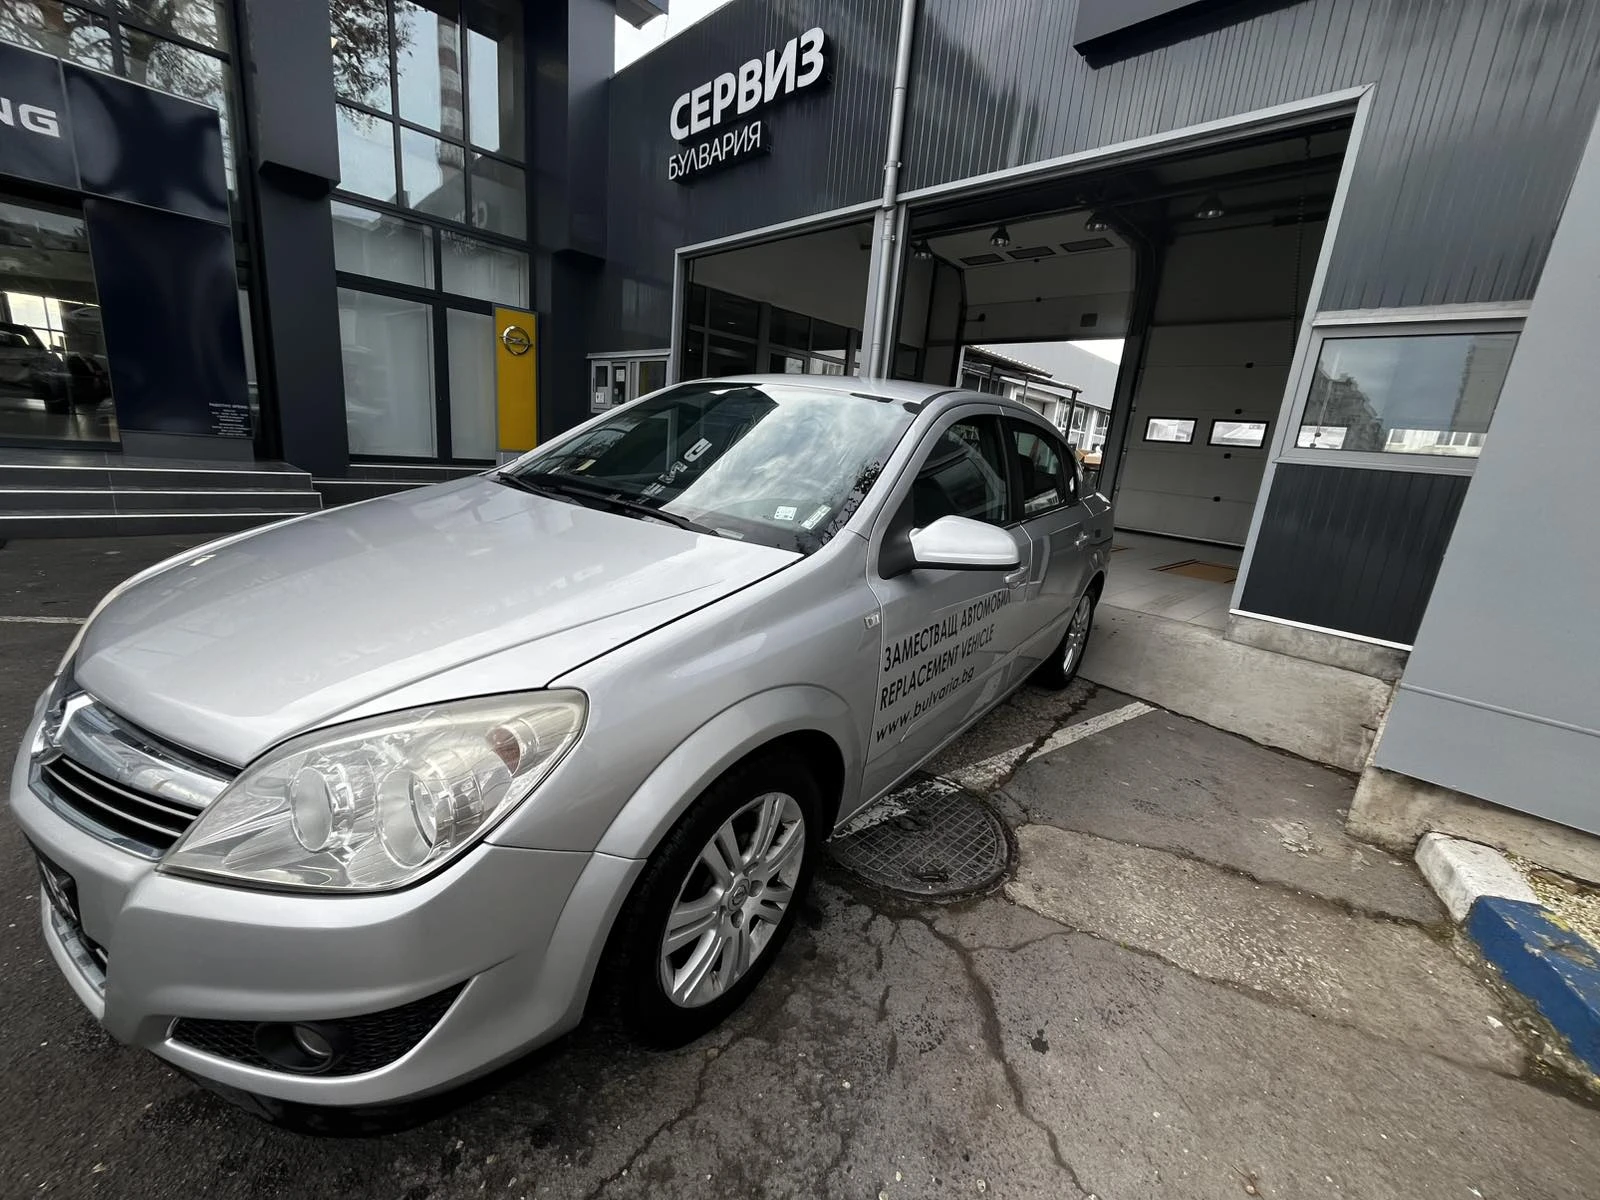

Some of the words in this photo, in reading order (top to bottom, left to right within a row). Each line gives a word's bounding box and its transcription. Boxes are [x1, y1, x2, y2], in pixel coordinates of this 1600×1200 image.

[669, 27, 825, 141] СЕРВИЗ
[668, 120, 762, 181] БУЛВАРИЯ
[880, 644, 960, 711] REPLACEMENT
[961, 623, 995, 659] VEHICLE
[884, 613, 958, 672] ЗАМЕСТВАЩ
[876, 666, 975, 743] www.bulvaria.bg
